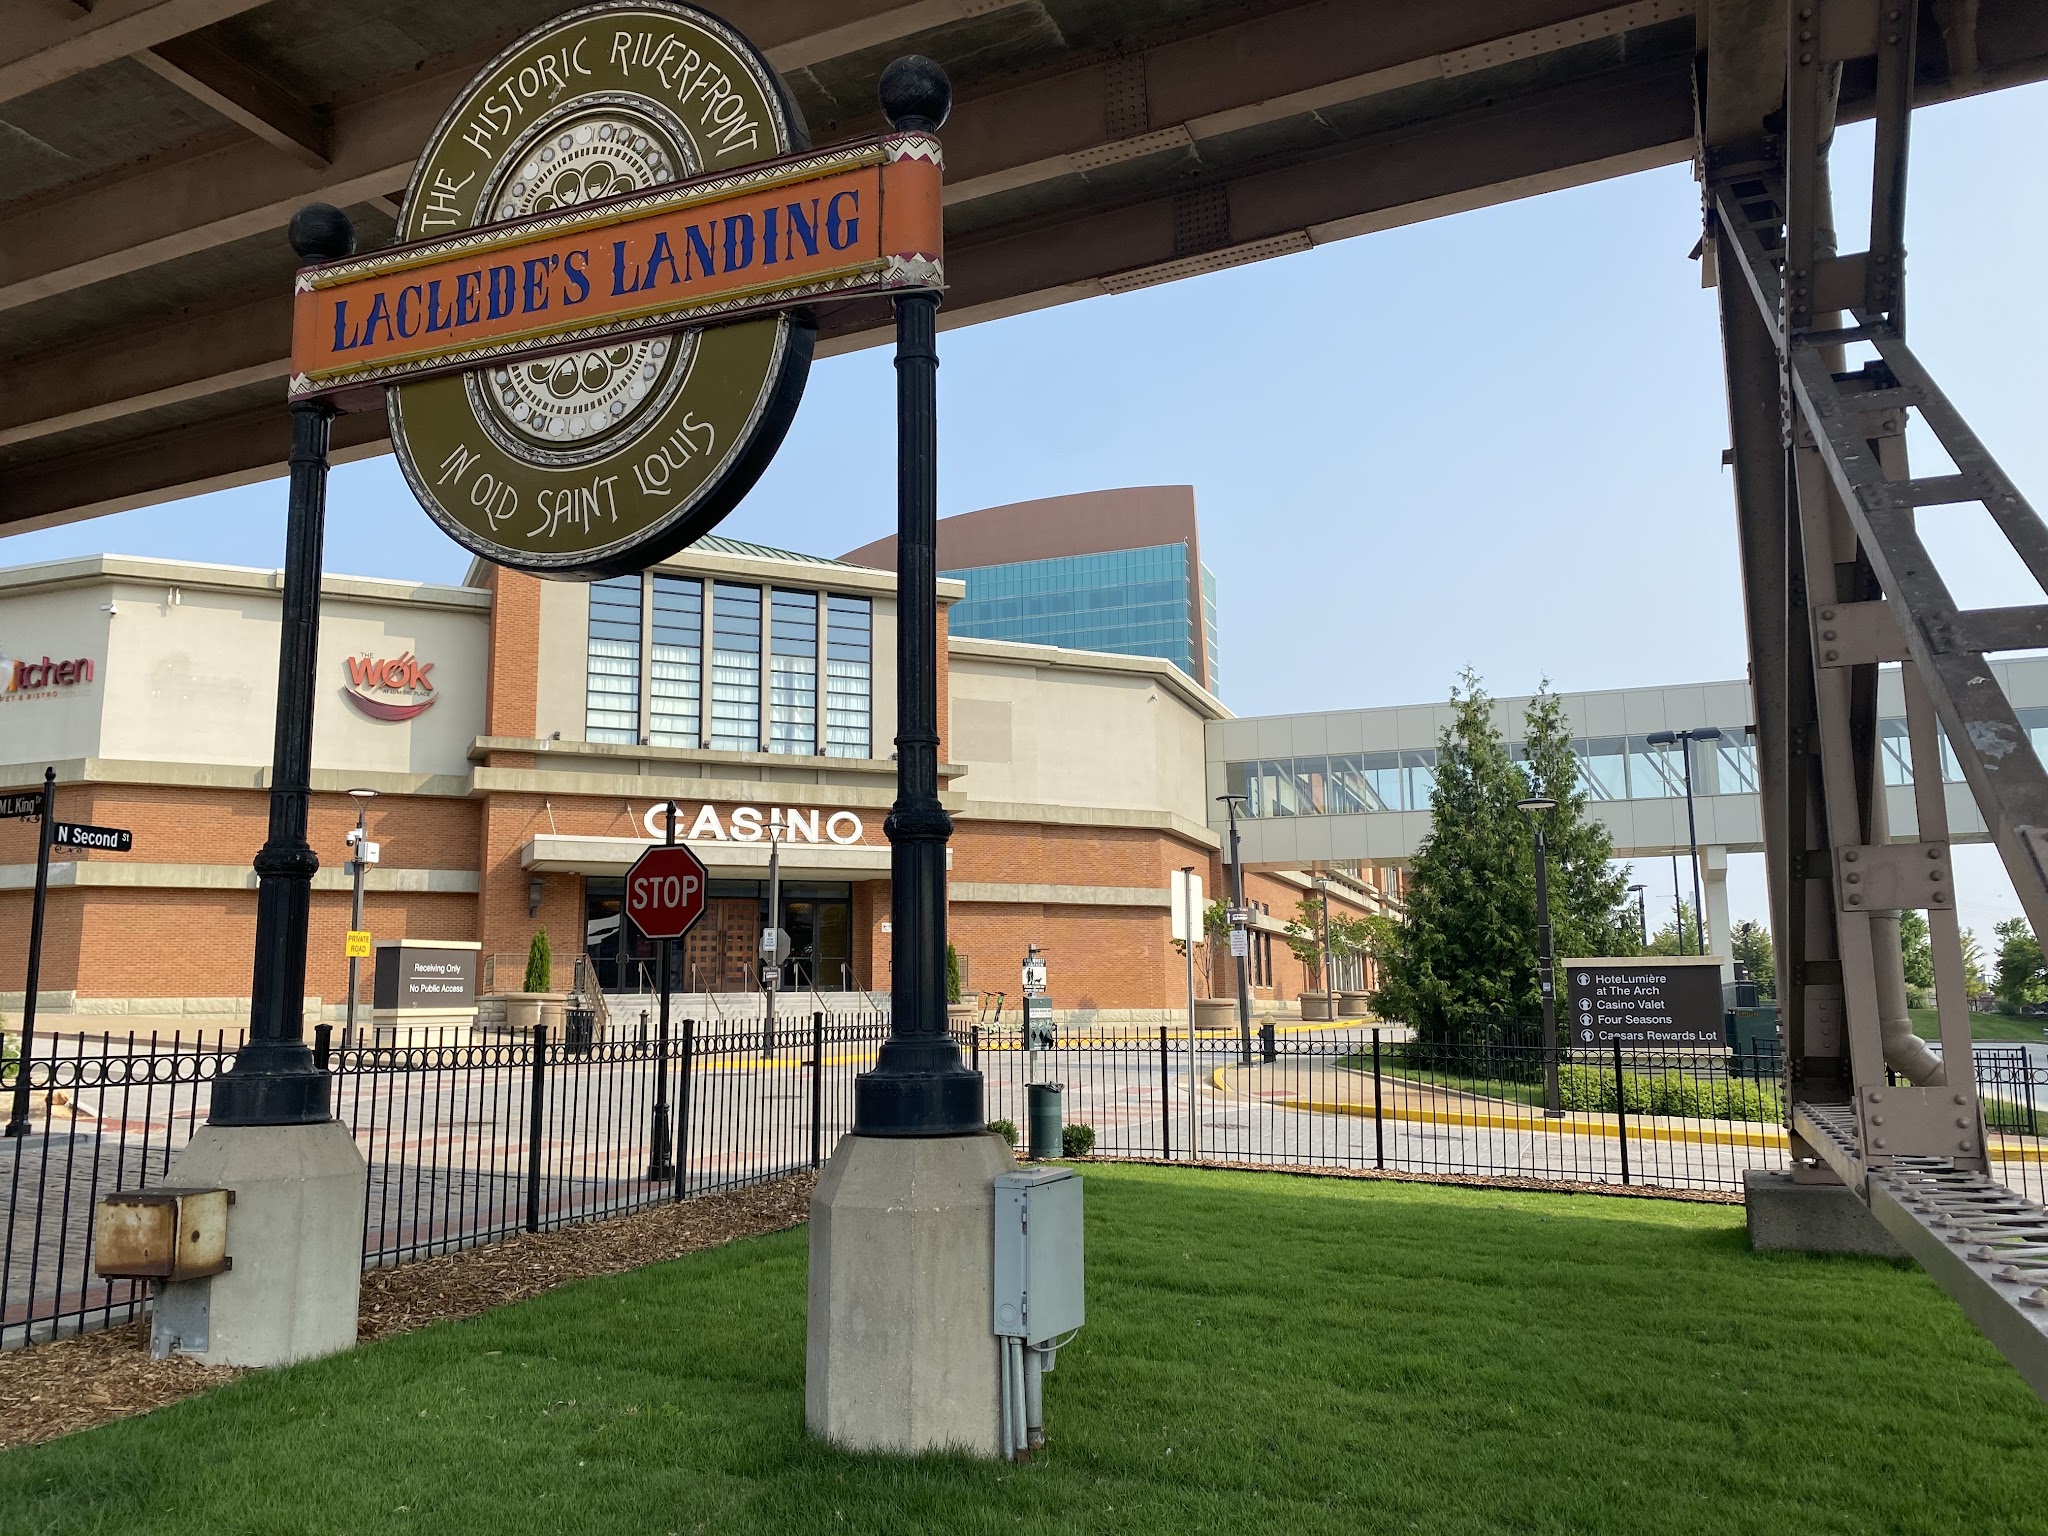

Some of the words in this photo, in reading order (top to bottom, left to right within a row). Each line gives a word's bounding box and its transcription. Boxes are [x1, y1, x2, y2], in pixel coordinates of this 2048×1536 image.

[421, 169, 475, 233] THE
[462, 37, 592, 159] HISTORIC
[609, 31, 758, 157] RIVERFRONT
[331, 249, 590, 353] LACLEDE'S
[609, 189, 861, 298] LANDING
[436, 443, 482, 487] IN
[470, 472, 519, 532] OLD
[526, 475, 619, 538] SAINT
[632, 411, 716, 497] LOUIS
[360, 651, 374, 659] THE
[348, 656, 435, 691] WOK
[15, 797, 35, 815] King
[643, 803, 863, 845] CASINO
[57, 825, 69, 842] N
[72, 828, 119, 848] Second
[121, 833, 130, 842] St
[632, 874, 699, 909] STOP
[348, 935, 370, 944] PRIVATE
[350, 945, 366, 953] ROAD
[414, 963, 445, 974] Receiving
[445, 963, 461, 974] Only
[409, 984, 419, 993] No
[420, 983, 440, 993] Public
[441, 984, 464, 993] Access
[1596, 987, 1607, 996] at
[1609, 986, 1631, 996] The
[1633, 985, 1660, 995] Arch
[1597, 1000, 1635, 1010] Casino
[1638, 1000, 1666, 1010] Valet
[1597, 1014, 1622, 1025] Four
[1625, 1014, 1673, 1025] Seasons
[1646, 1030, 1696, 1041] Rewards
[1698, 1030, 1718, 1041] Lot
